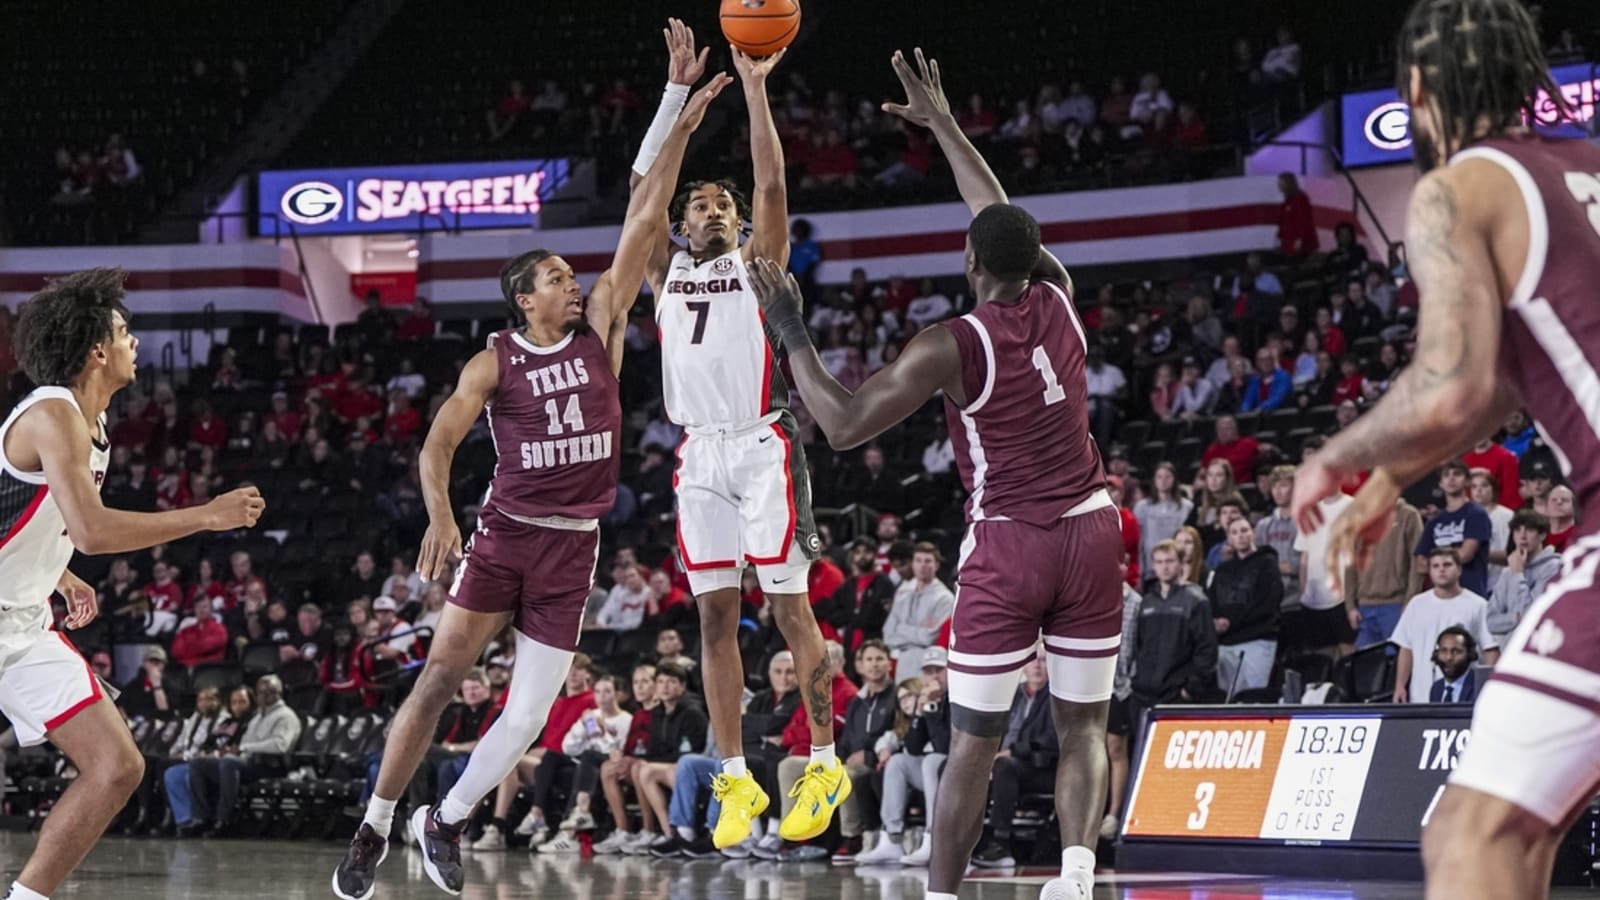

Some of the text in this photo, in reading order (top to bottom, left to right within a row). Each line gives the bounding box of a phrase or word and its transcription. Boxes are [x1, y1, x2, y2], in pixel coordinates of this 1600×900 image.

[357, 171, 543, 222] SEATGEEK
[667, 278, 743, 295] GEORGIA
[685, 301, 711, 345] 7
[525, 358, 590, 397] TEXAS
[1032, 345, 1066, 406] 1
[545, 393, 585, 435] 14
[520, 431, 612, 469] SOUTHERN
[1164, 730, 1266, 769] GEORGIA
[1295, 725, 1367, 754] 18:19
[1187, 782, 1216, 830] 3
[1295, 789, 1334, 807] POSS
[1332, 813, 1344, 832] 2
